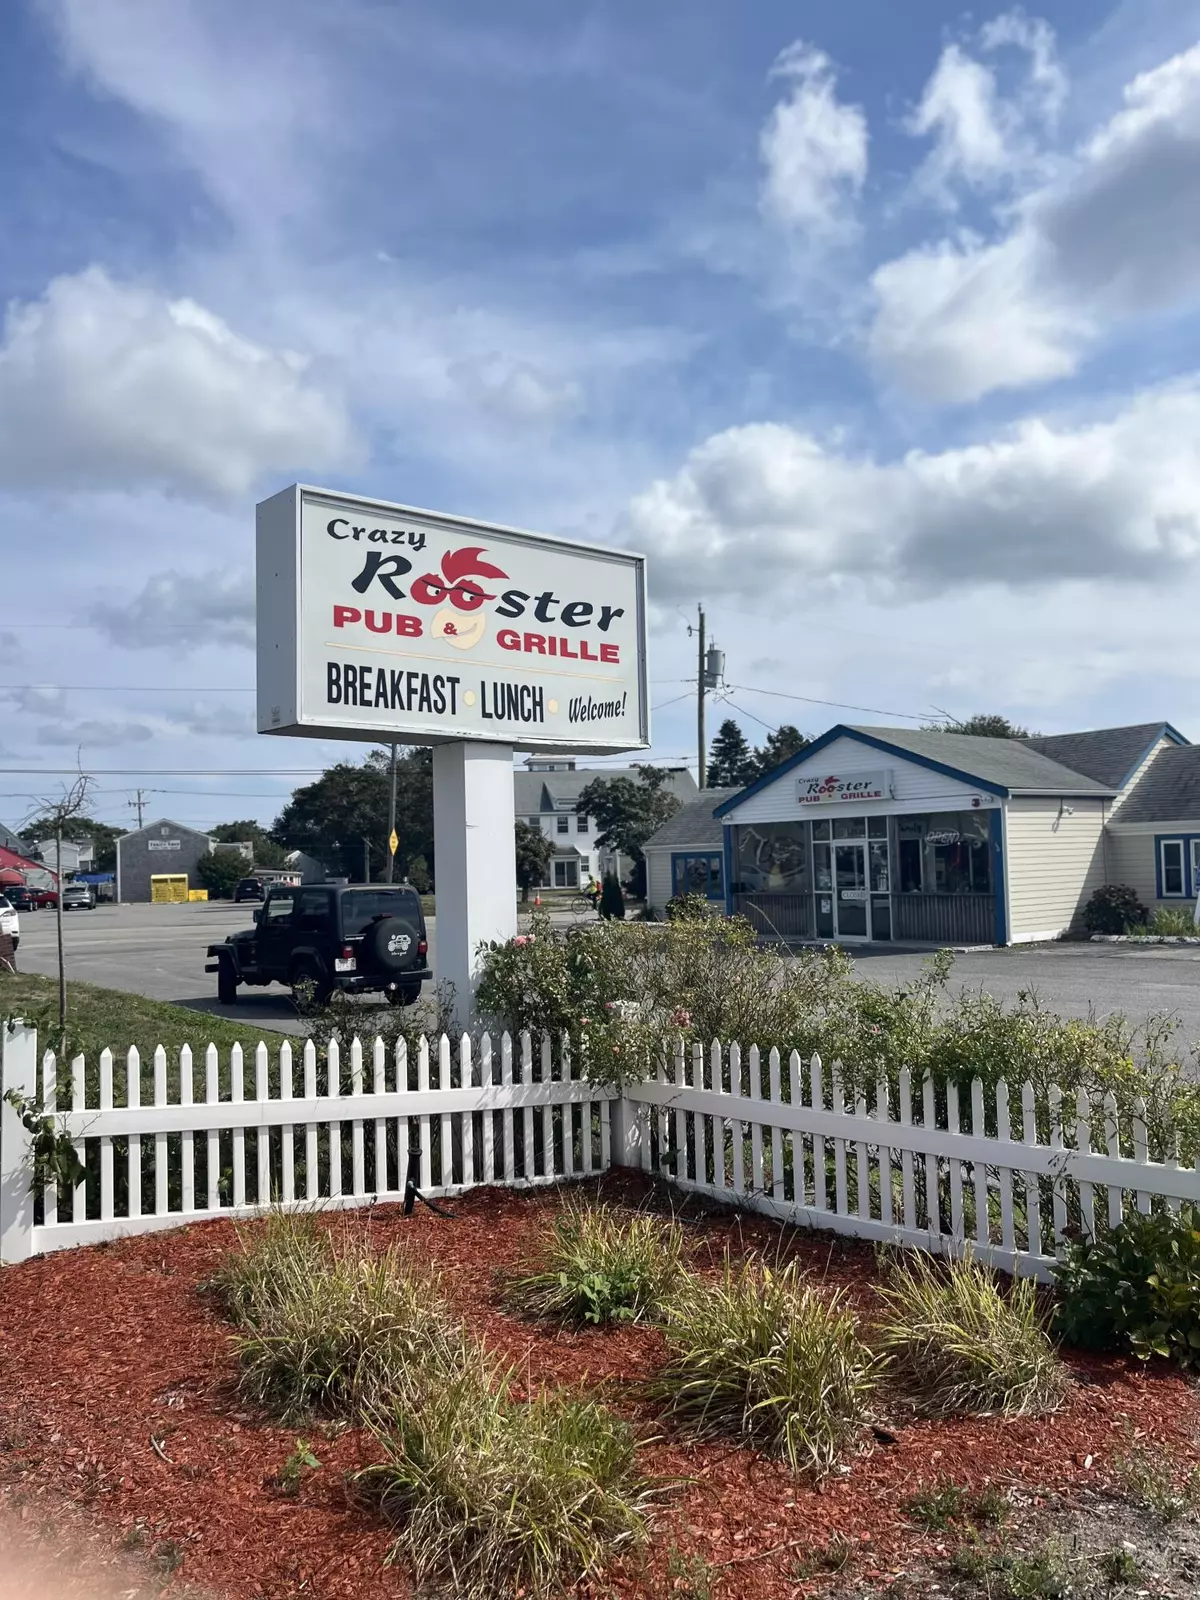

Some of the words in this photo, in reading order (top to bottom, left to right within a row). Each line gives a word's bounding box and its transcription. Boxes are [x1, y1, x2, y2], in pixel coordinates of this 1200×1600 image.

[326, 518, 427, 552] Crazy
[351, 550, 625, 632] Rooster
[333, 605, 424, 638] PUB
[443, 622, 458, 636] &
[495, 629, 620, 664] GRILLE
[326, 661, 460, 715] BREAKFAST
[480, 680, 544, 723] LUNCH
[568, 691, 627, 724] Welcome!
[798, 795, 820, 803] PUB
[840, 790, 882, 800] GRILLE
[806, 781, 872, 794] Rooster
